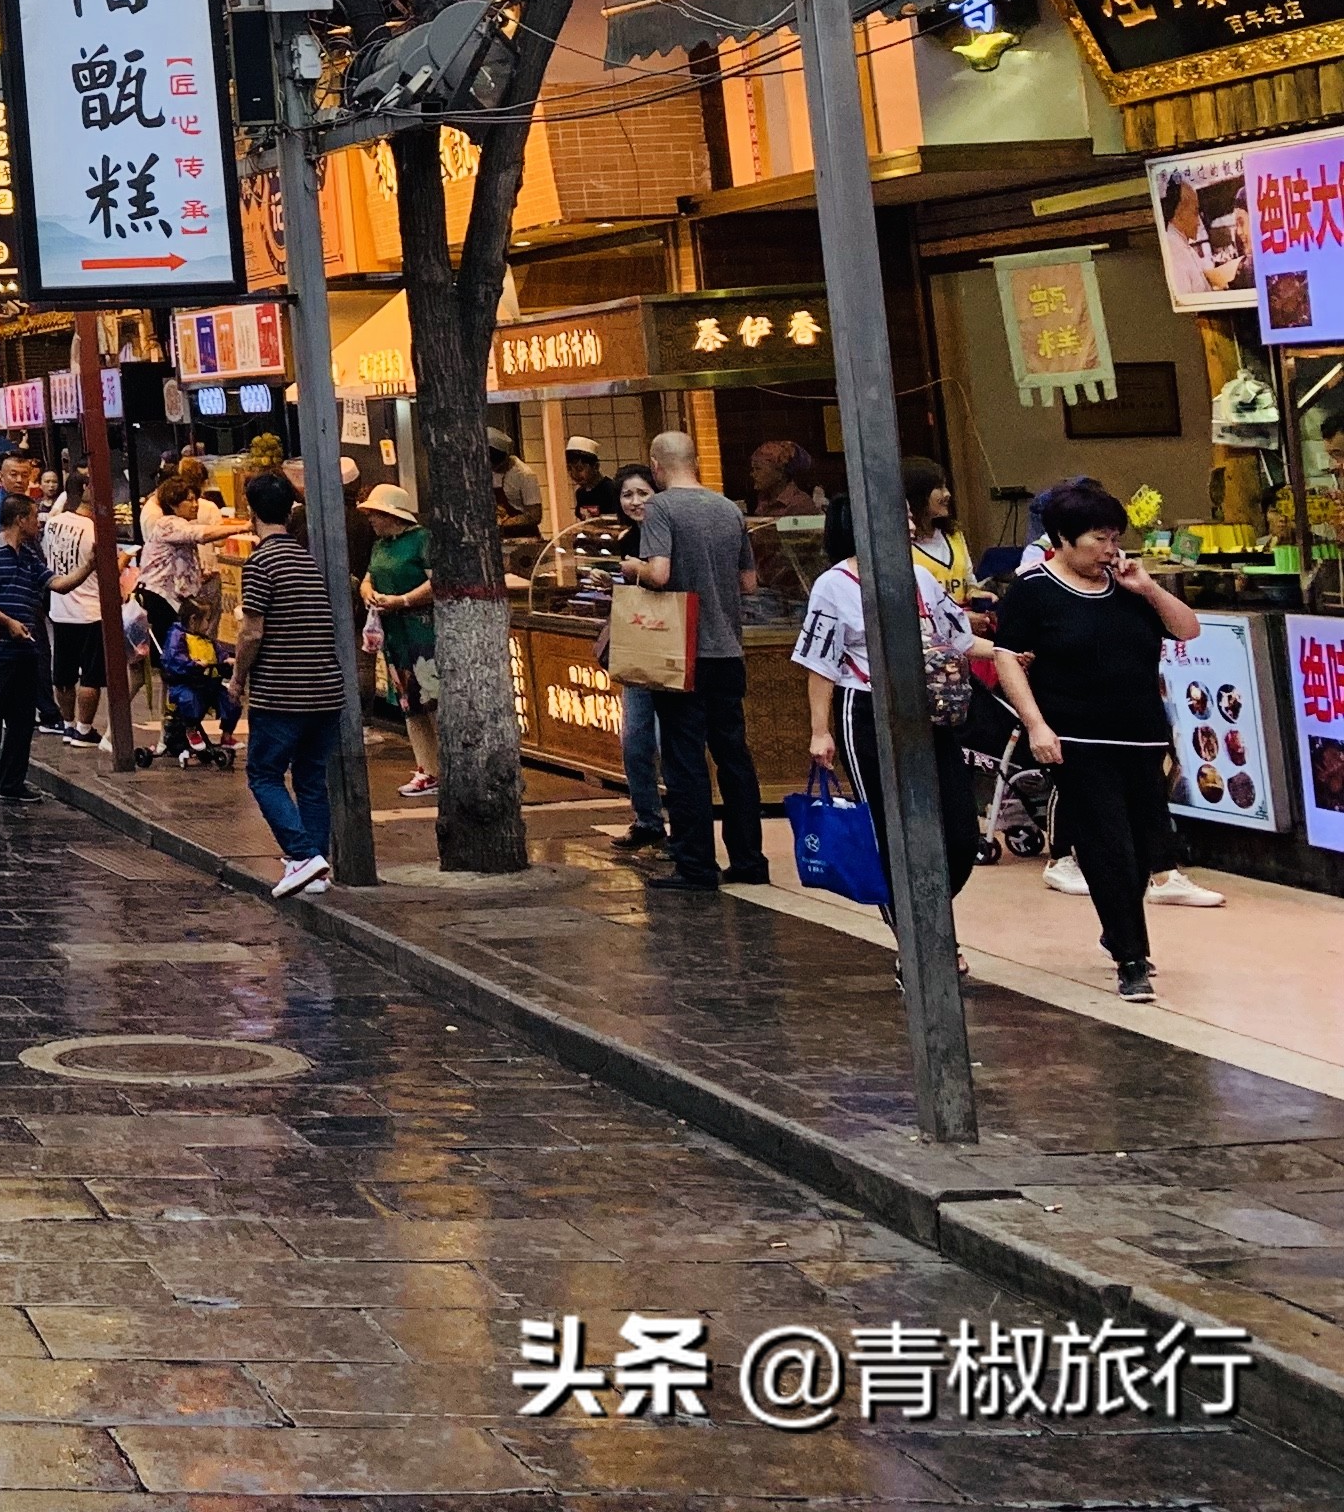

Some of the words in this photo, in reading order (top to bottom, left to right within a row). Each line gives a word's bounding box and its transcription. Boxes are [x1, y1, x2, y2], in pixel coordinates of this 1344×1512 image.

[1256, 160, 1344, 256] 绝味大
[693, 309, 822, 353] 秦伊香
